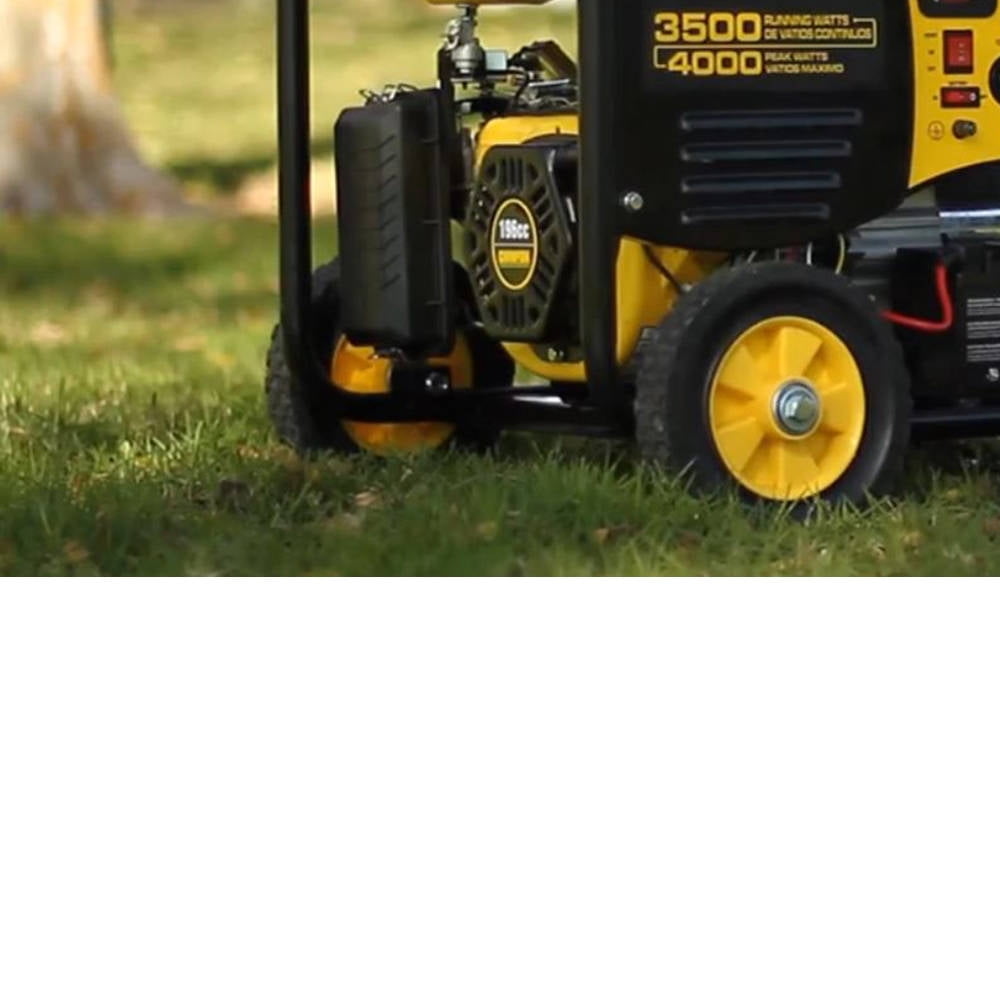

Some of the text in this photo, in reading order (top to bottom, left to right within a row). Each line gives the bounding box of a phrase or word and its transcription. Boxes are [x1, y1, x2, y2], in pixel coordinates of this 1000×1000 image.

[655, 12, 762, 42] 3500
[764, 14, 849, 26] RUNNING WATTS
[668, 51, 762, 75] 4000
